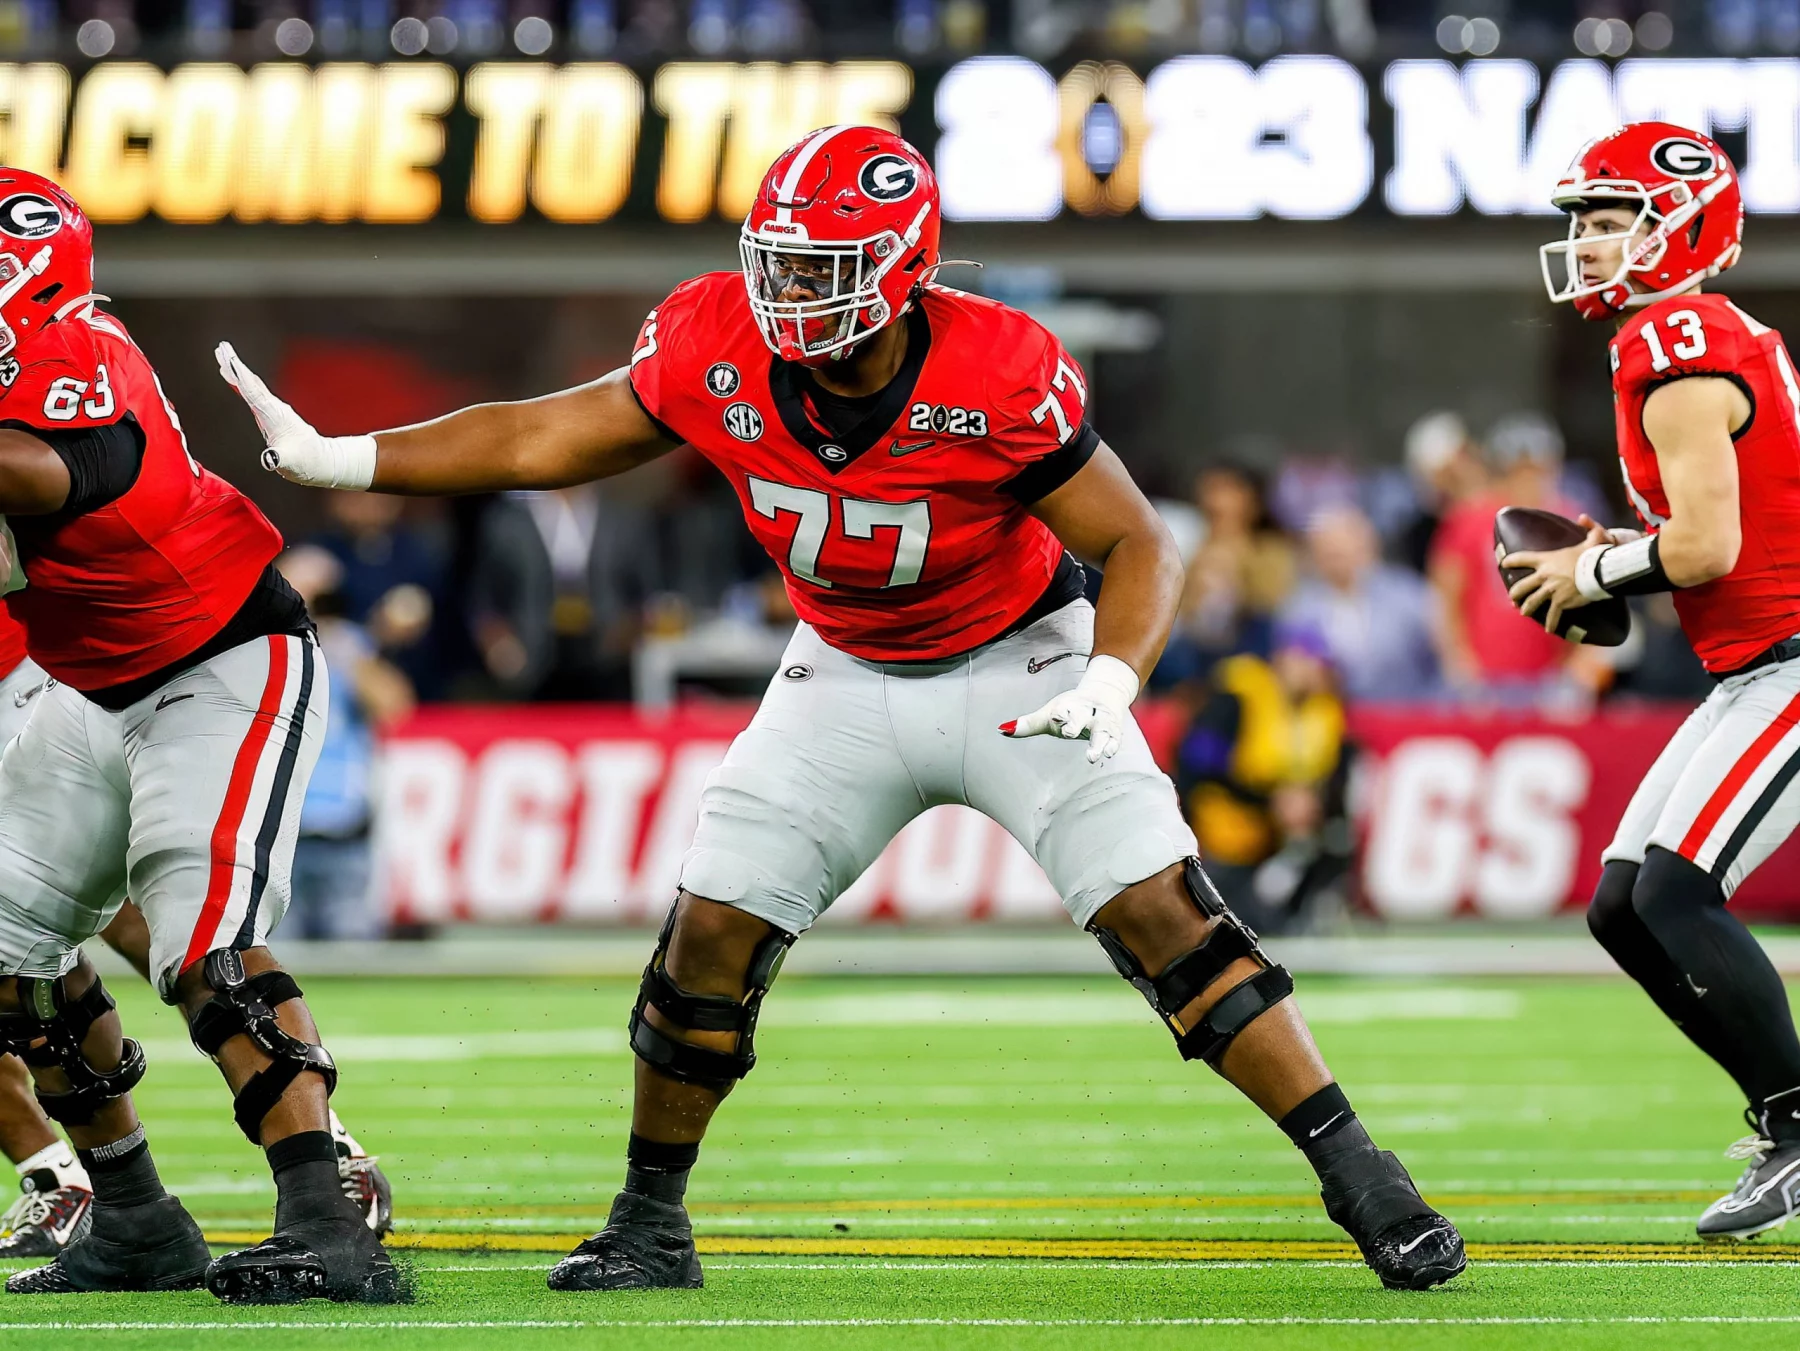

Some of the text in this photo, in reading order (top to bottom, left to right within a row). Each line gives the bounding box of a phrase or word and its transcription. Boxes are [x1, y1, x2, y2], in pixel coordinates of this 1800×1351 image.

[0, 62, 458, 223] LCOME
[465, 62, 645, 223] TO
[1664, 141, 1714, 172] G
[871, 159, 918, 193] G
[9, 199, 60, 230] G
[763, 222, 798, 235] DAWGS
[1640, 308, 1709, 374] 13
[42, 363, 117, 421] 63
[1030, 358, 1087, 446] 77
[725, 404, 762, 440] SEC
[909, 402, 989, 437] 2023
[746, 474, 932, 590] 77
